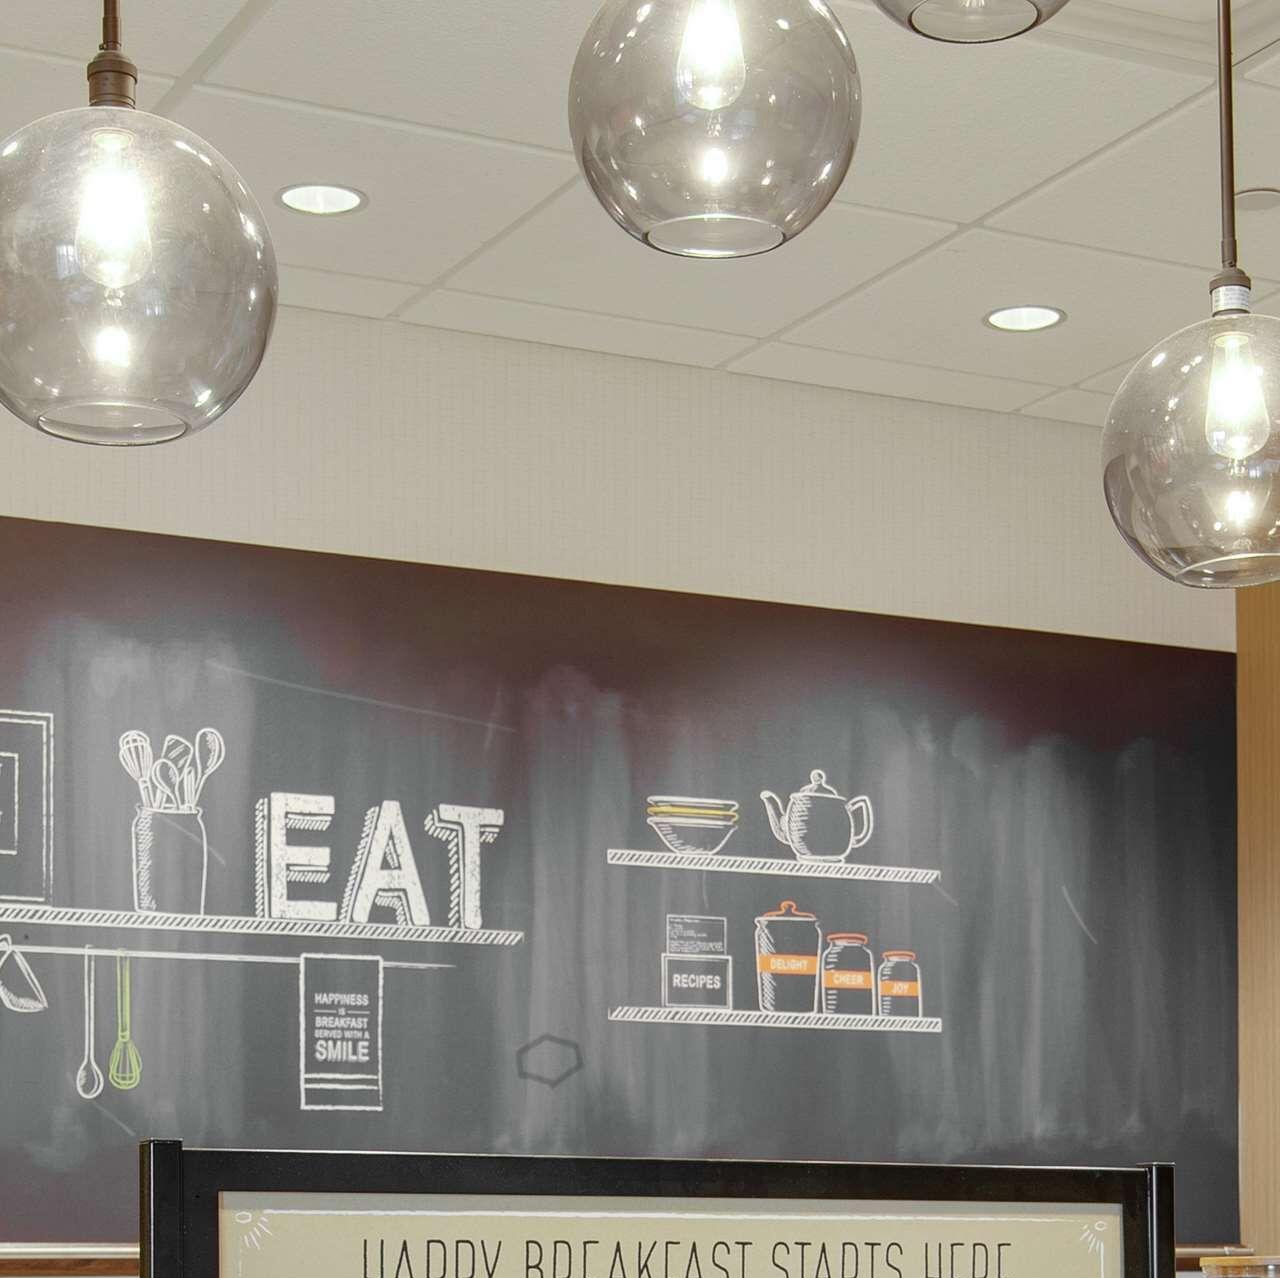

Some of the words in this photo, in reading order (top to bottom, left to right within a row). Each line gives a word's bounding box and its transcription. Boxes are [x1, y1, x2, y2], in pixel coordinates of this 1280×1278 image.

[256, 792, 504, 929] EAT
[770, 959, 808, 971] DELIGHT
[672, 974, 721, 989] RECIPES
[833, 975, 864, 985] CHEER
[892, 983, 909, 994] JOY
[314, 993, 369, 1006] HAPPINESS
[315, 1016, 369, 1029] BREAKFAST
[314, 1030, 342, 1039] SERVED
[344, 1031, 362, 1039] WITH
[364, 1031, 370, 1039] A
[314, 1040, 370, 1062] SMILE
